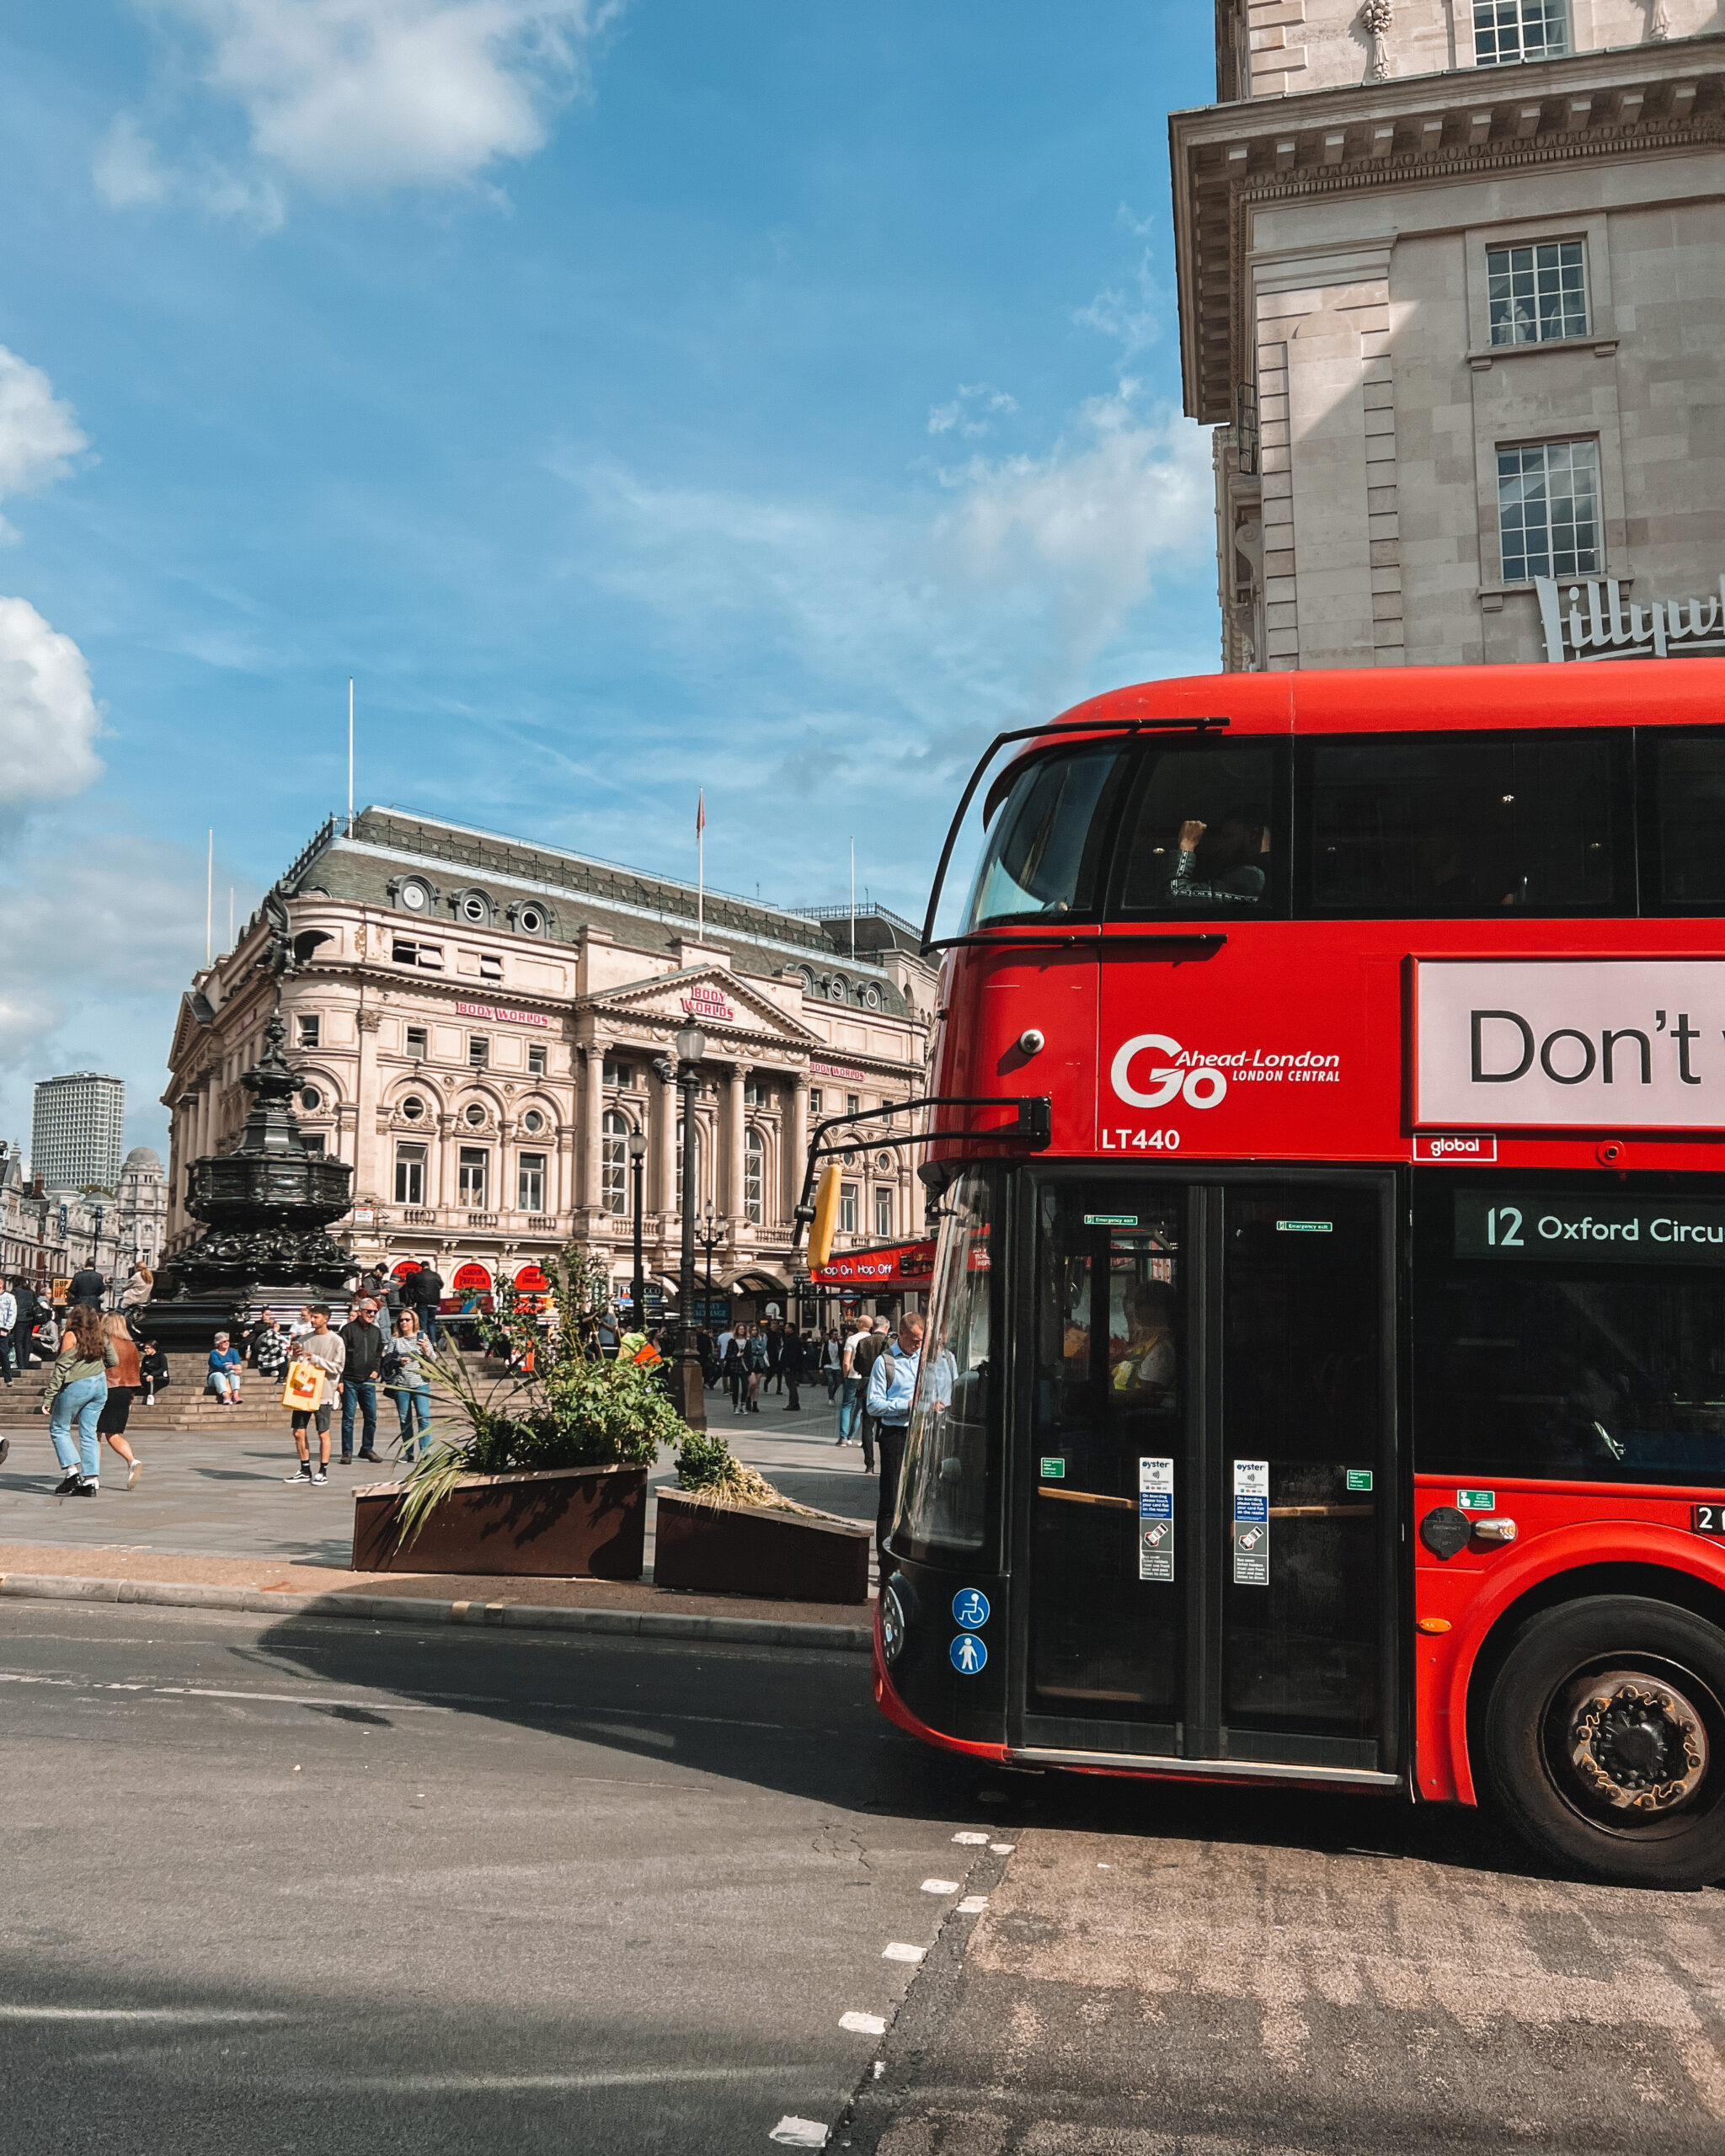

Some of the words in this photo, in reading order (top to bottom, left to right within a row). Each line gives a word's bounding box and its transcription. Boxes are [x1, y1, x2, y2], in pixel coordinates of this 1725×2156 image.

[1535, 574, 1725, 663] Lillyw
[694, 987, 725, 1003] BODY
[458, 1002, 494, 1018] BODY
[497, 1007, 549, 1026] WORLDS
[684, 999, 734, 1019] WORLDS
[1471, 1010, 1701, 1085] Don't
[809, 1062, 830, 1074] BODY
[831, 1066, 864, 1080] WORLDS
[1110, 1033, 1227, 1109] Go
[1175, 1049, 1340, 1068] Ahead-London
[1232, 1070, 1284, 1081] LONDON
[1288, 1070, 1340, 1082] CENTRAL
[1102, 1129, 1180, 1150] LT440
[1430, 1137, 1480, 1157] global
[1487, 1207, 1525, 1246] 12
[1538, 1215, 1639, 1241] Oxford
[840, 1264, 853, 1275] On
[857, 1264, 875, 1275] Hop
[878, 1263, 892, 1274] Off
